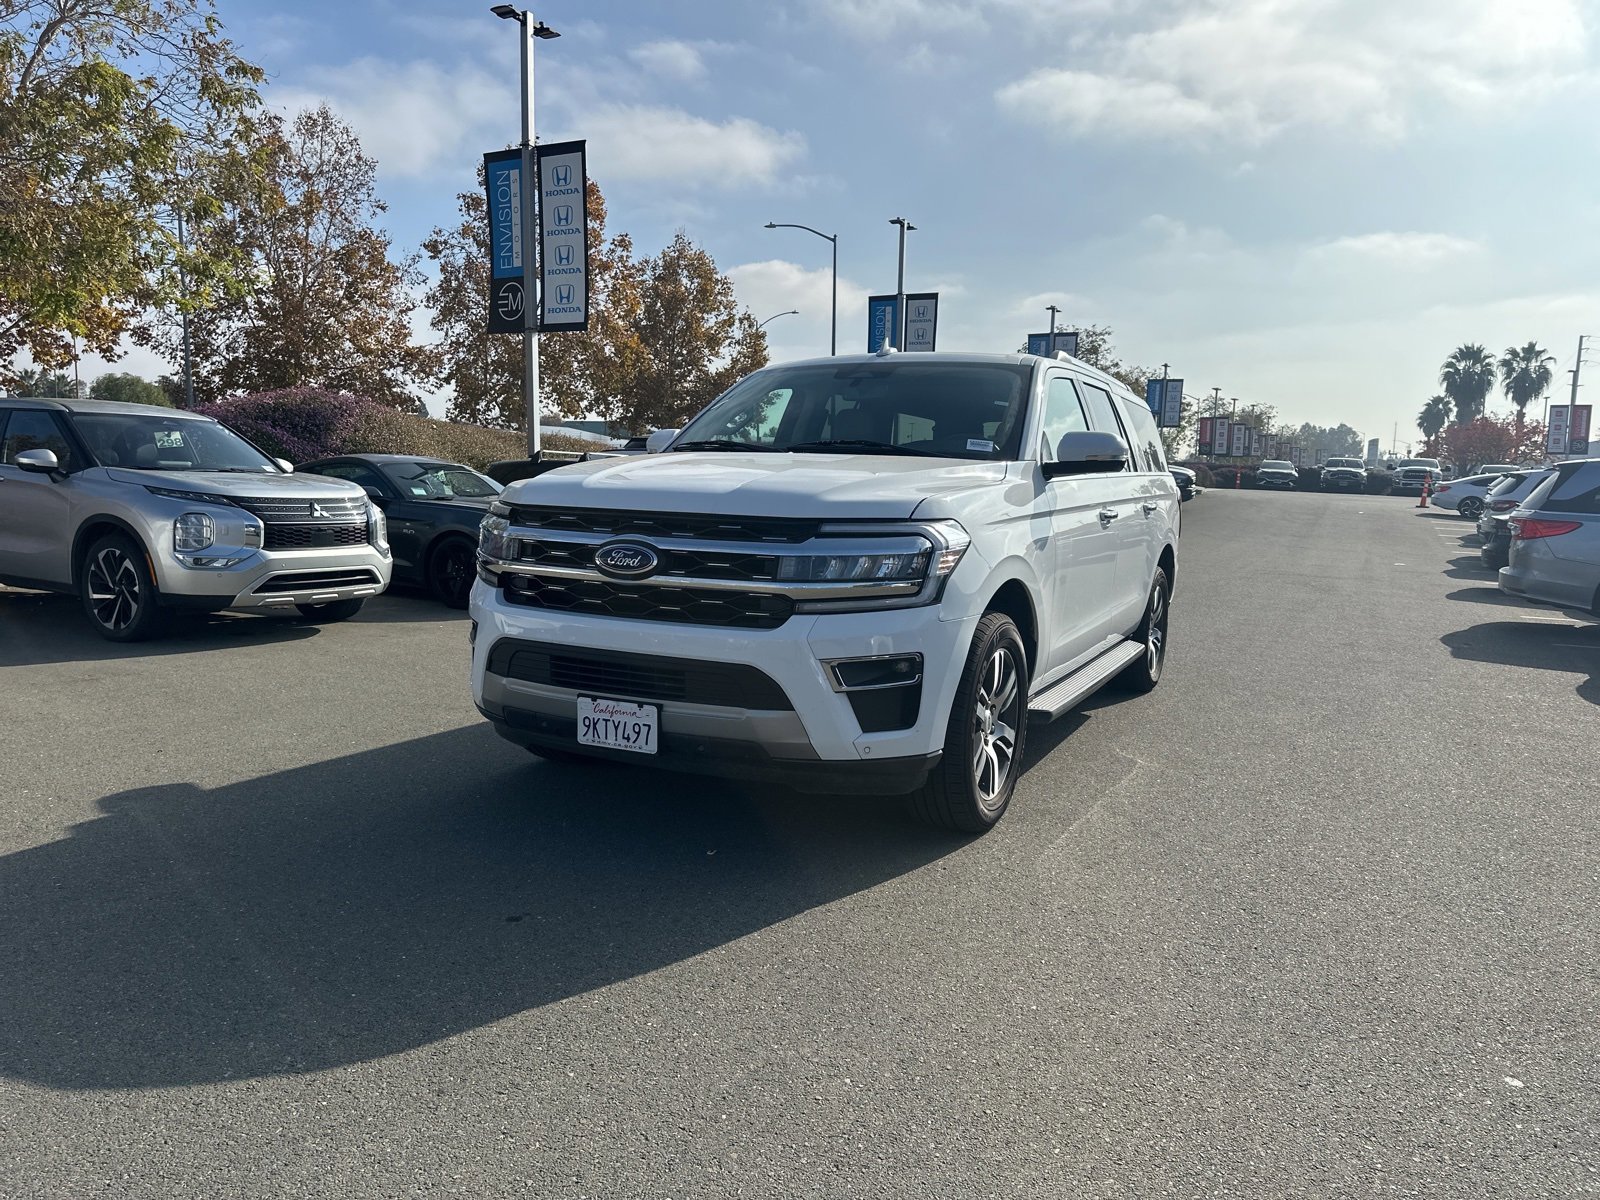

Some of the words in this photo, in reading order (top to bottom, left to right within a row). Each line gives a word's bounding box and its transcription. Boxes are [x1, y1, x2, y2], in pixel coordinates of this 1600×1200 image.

[545, 188, 580, 197] HONDA
[496, 170, 513, 269] ENVISION
[512, 178, 521, 260] MOTORS
[546, 228, 581, 237] HONDA
[547, 267, 582, 276] HONDA
[547, 306, 582, 314] HONDA
[158, 437, 182, 448] 298
[607, 549, 642, 567] Ford
[593, 703, 642, 718] California
[582, 716, 652, 746] 9KTY497
